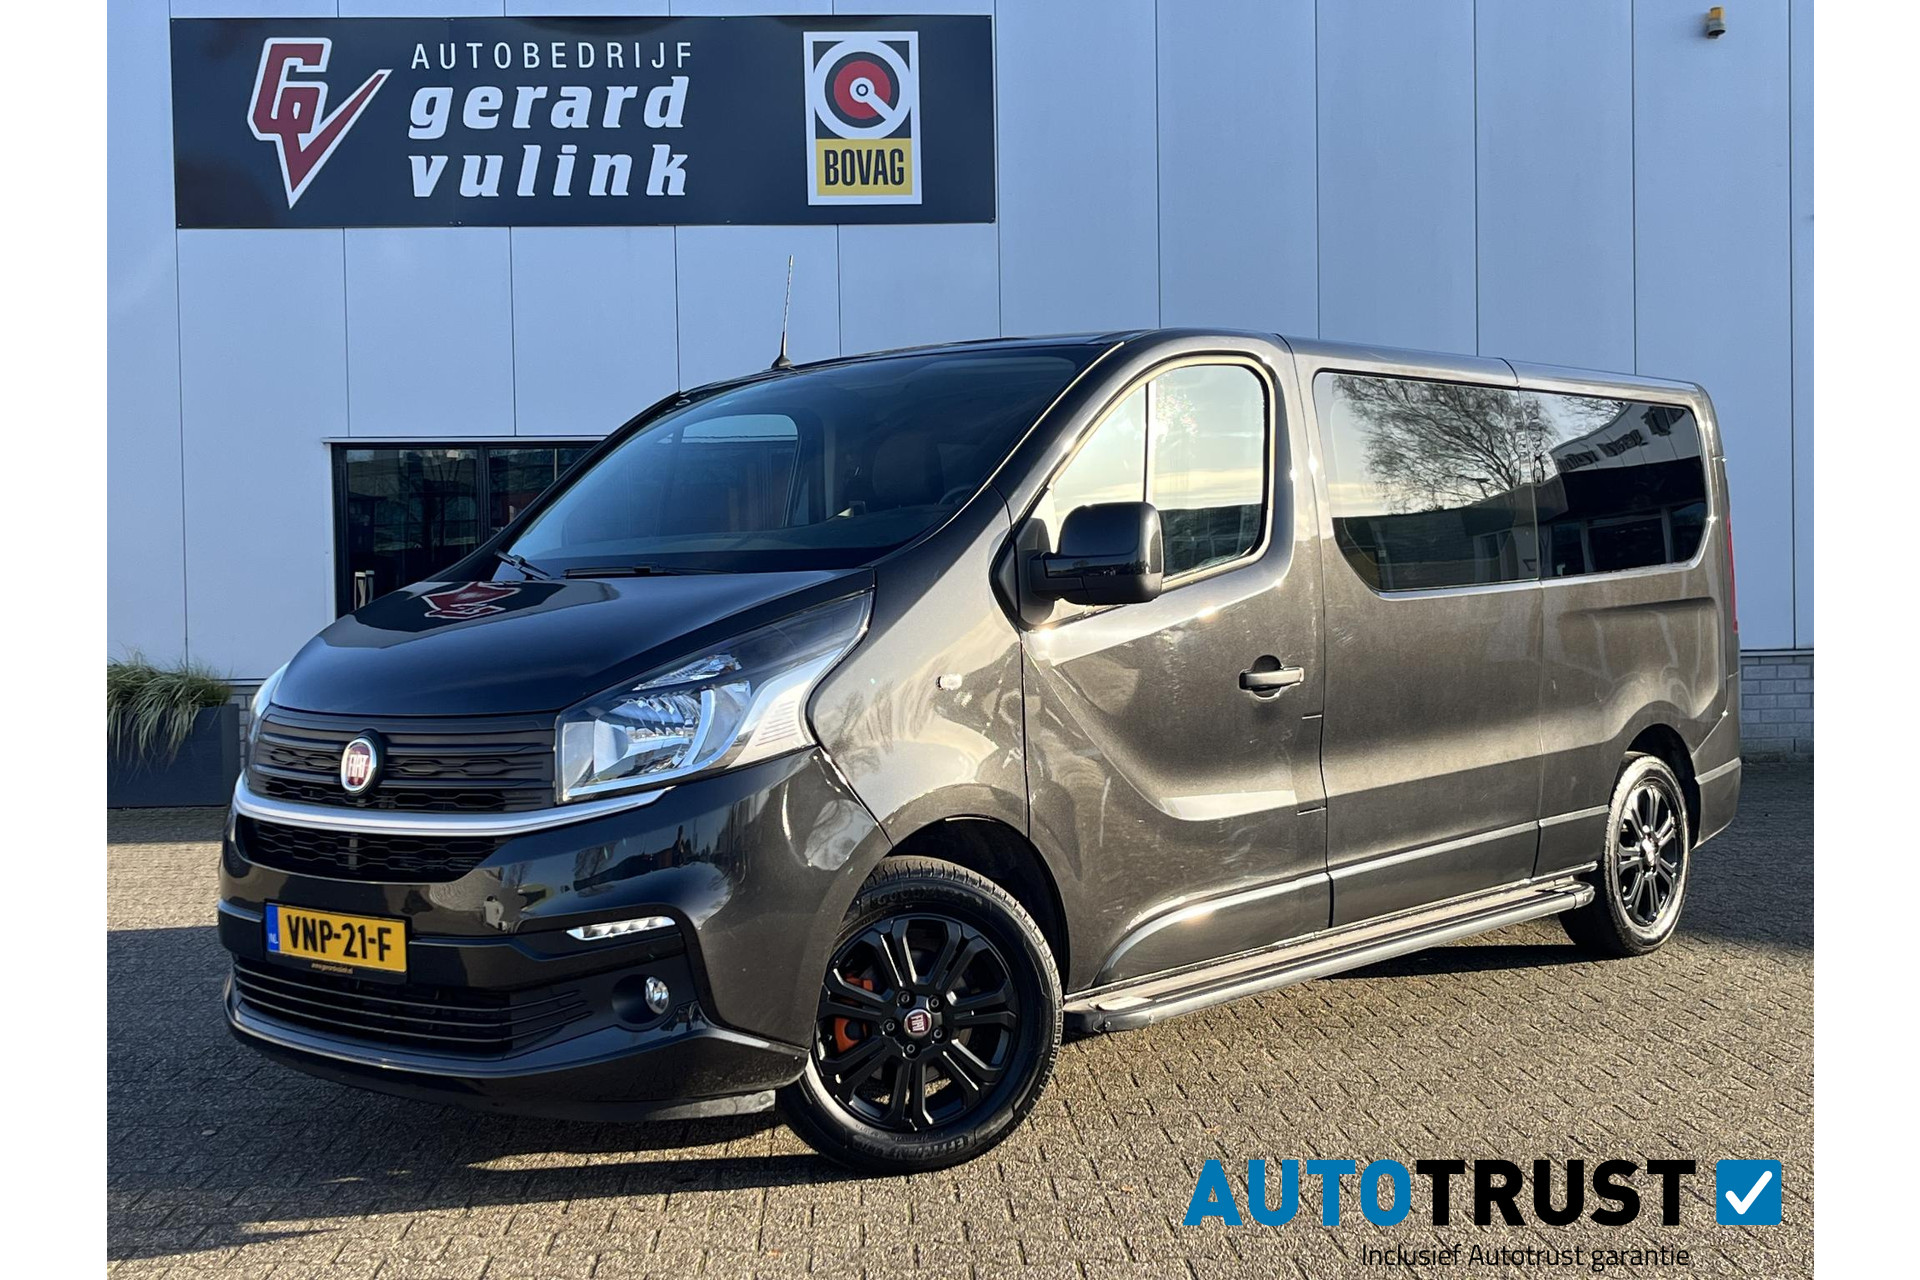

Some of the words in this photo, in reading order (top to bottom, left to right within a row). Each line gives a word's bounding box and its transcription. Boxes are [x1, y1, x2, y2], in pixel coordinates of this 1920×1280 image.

[411, 42, 691, 69] AUTOBEDRIJF
[408, 76, 690, 140] gerard
[408, 144, 689, 198] vulink
[824, 148, 905, 186] BOVAG
[347, 753, 370, 778] FIAT
[286, 914, 392, 962] VNP-21-F
